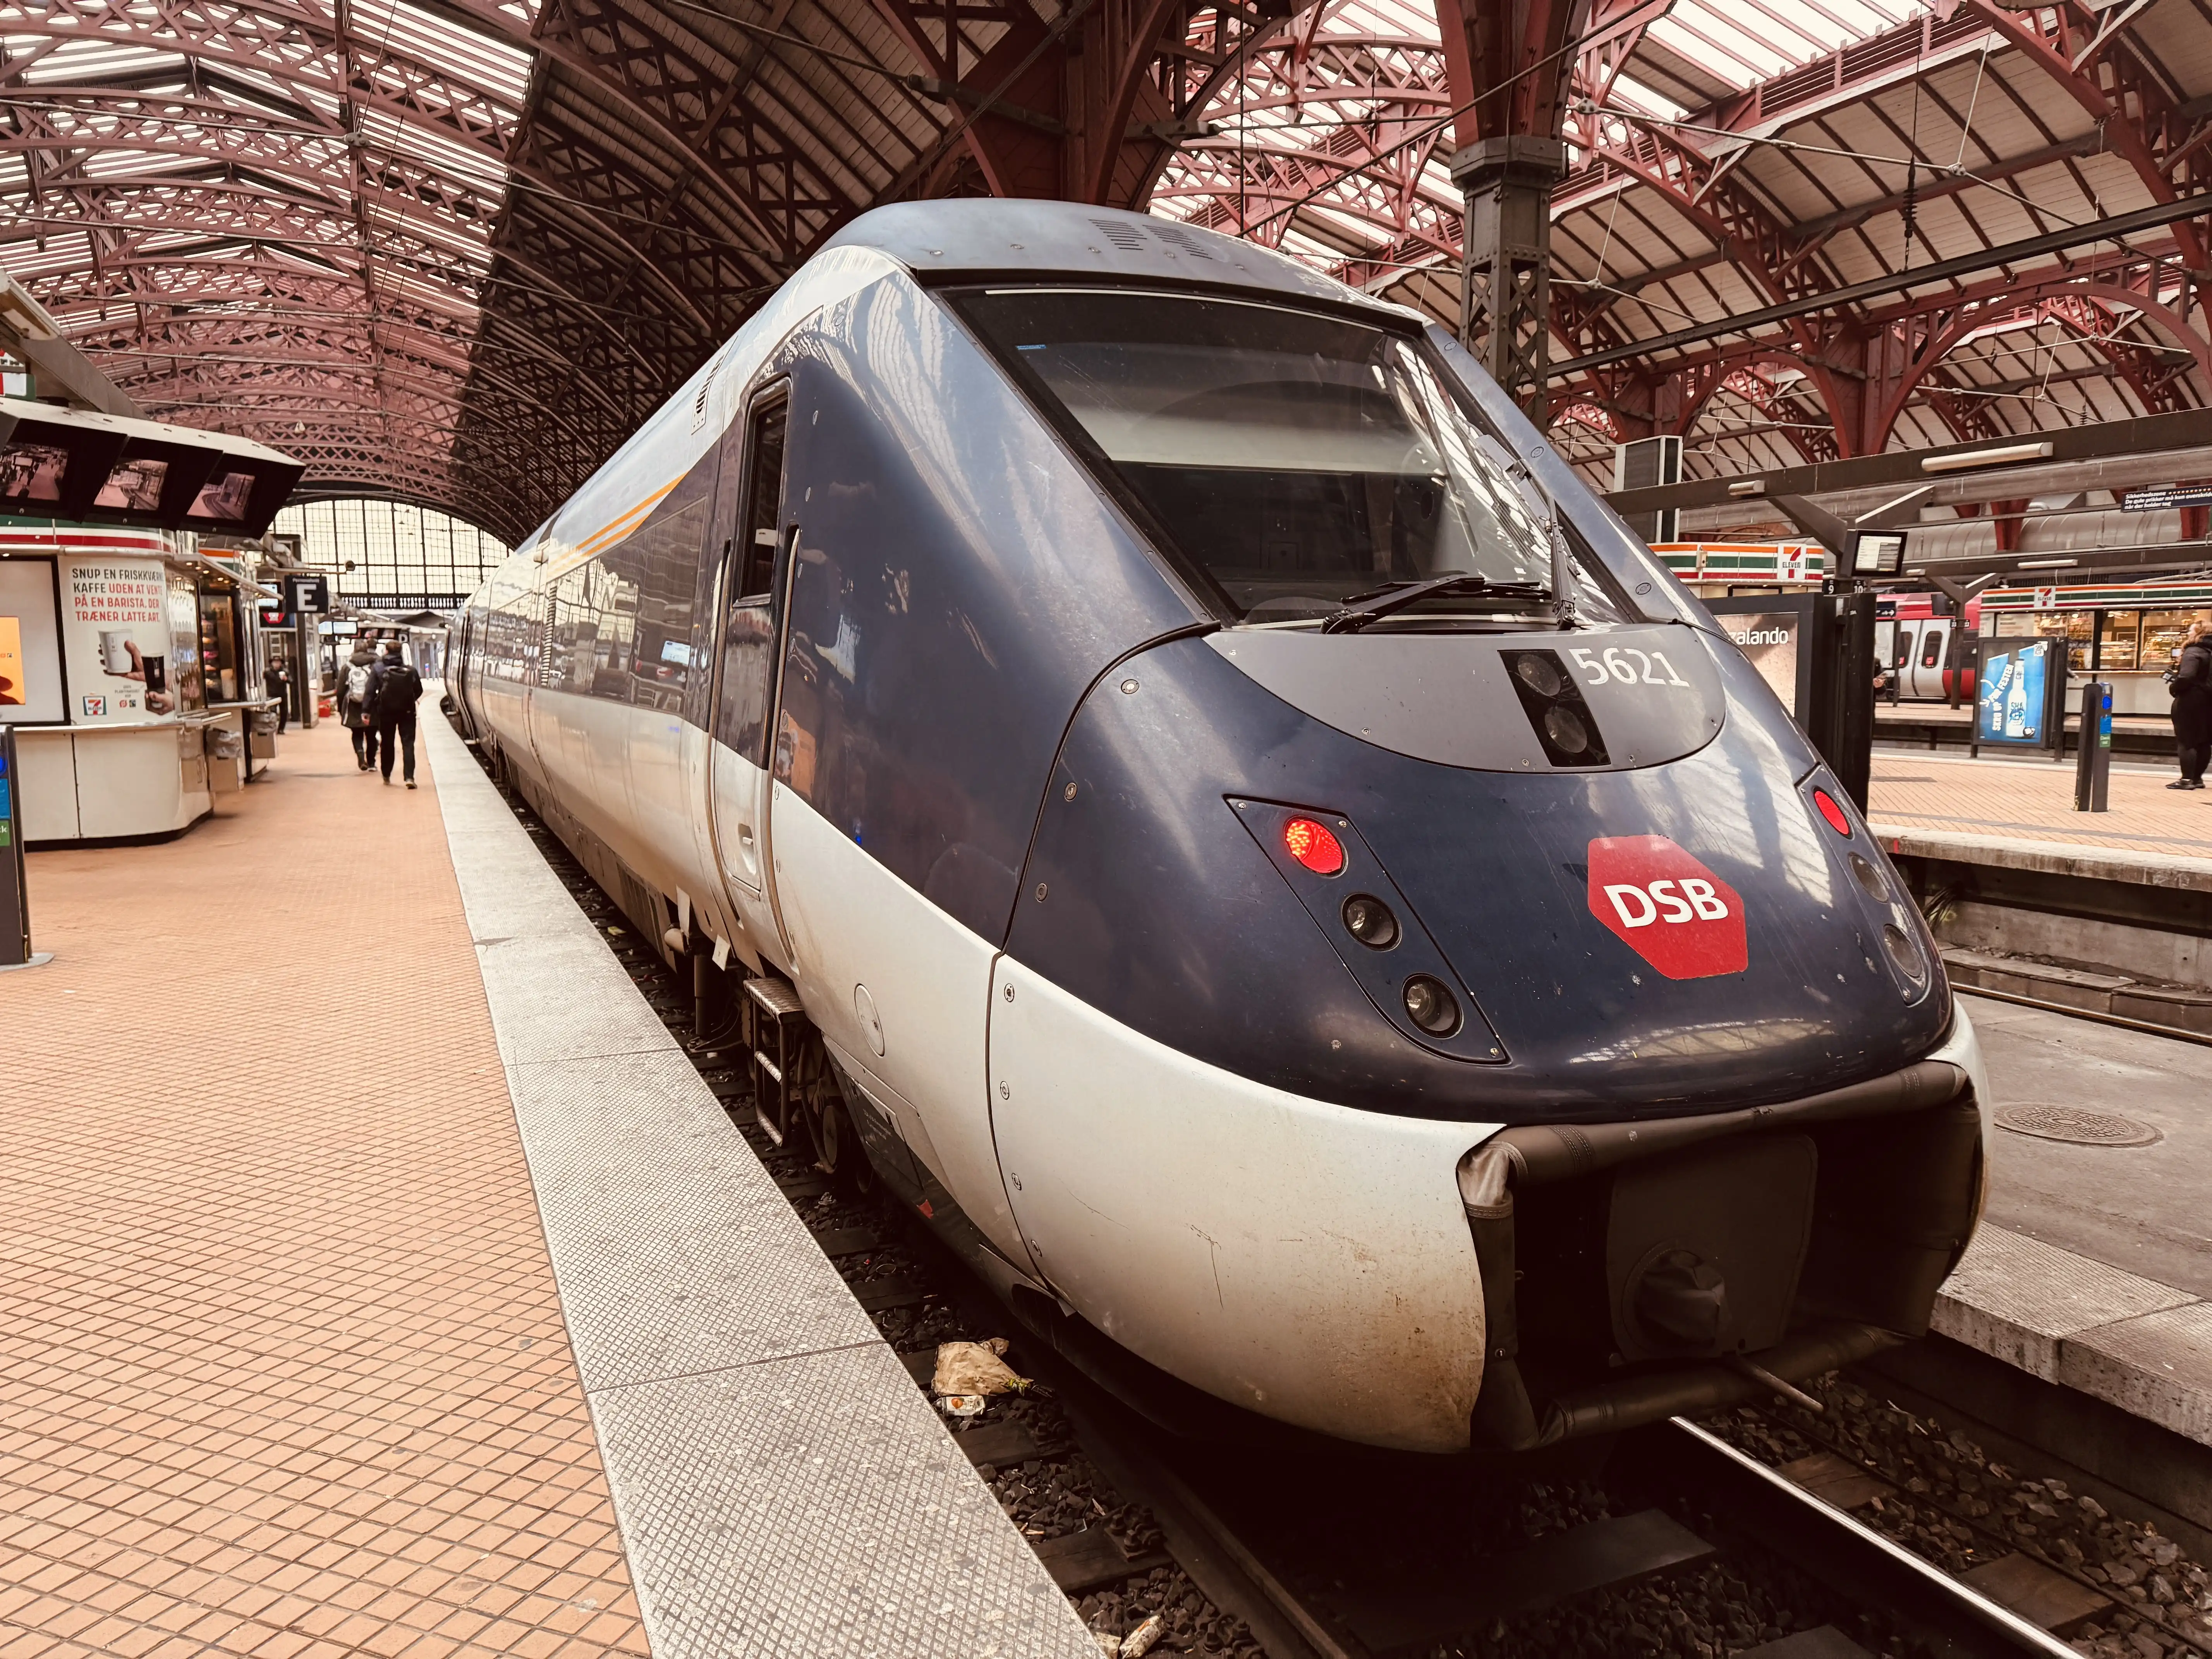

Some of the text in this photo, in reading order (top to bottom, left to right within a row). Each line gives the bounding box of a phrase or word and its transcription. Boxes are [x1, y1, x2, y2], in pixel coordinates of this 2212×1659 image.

[1783, 546, 1801, 578] 7
[72, 568, 100, 579] SNUP
[104, 569, 116, 579] EN
[74, 582, 162, 595] KAFFE UDEN AT VENTE
[297, 584, 318, 611] E
[1828, 585, 1863, 594] 9 10
[2039, 588, 2052, 606] 7
[75, 593, 88, 608] PÅ
[91, 597, 104, 607] EN
[148, 599, 159, 608] DER
[76, 611, 118, 622] TRÆNER
[122, 611, 146, 622] LATTE
[1728, 627, 1788, 645] zalando
[1568, 647, 1690, 687] 5621
[1603, 878, 1728, 928] DSB
